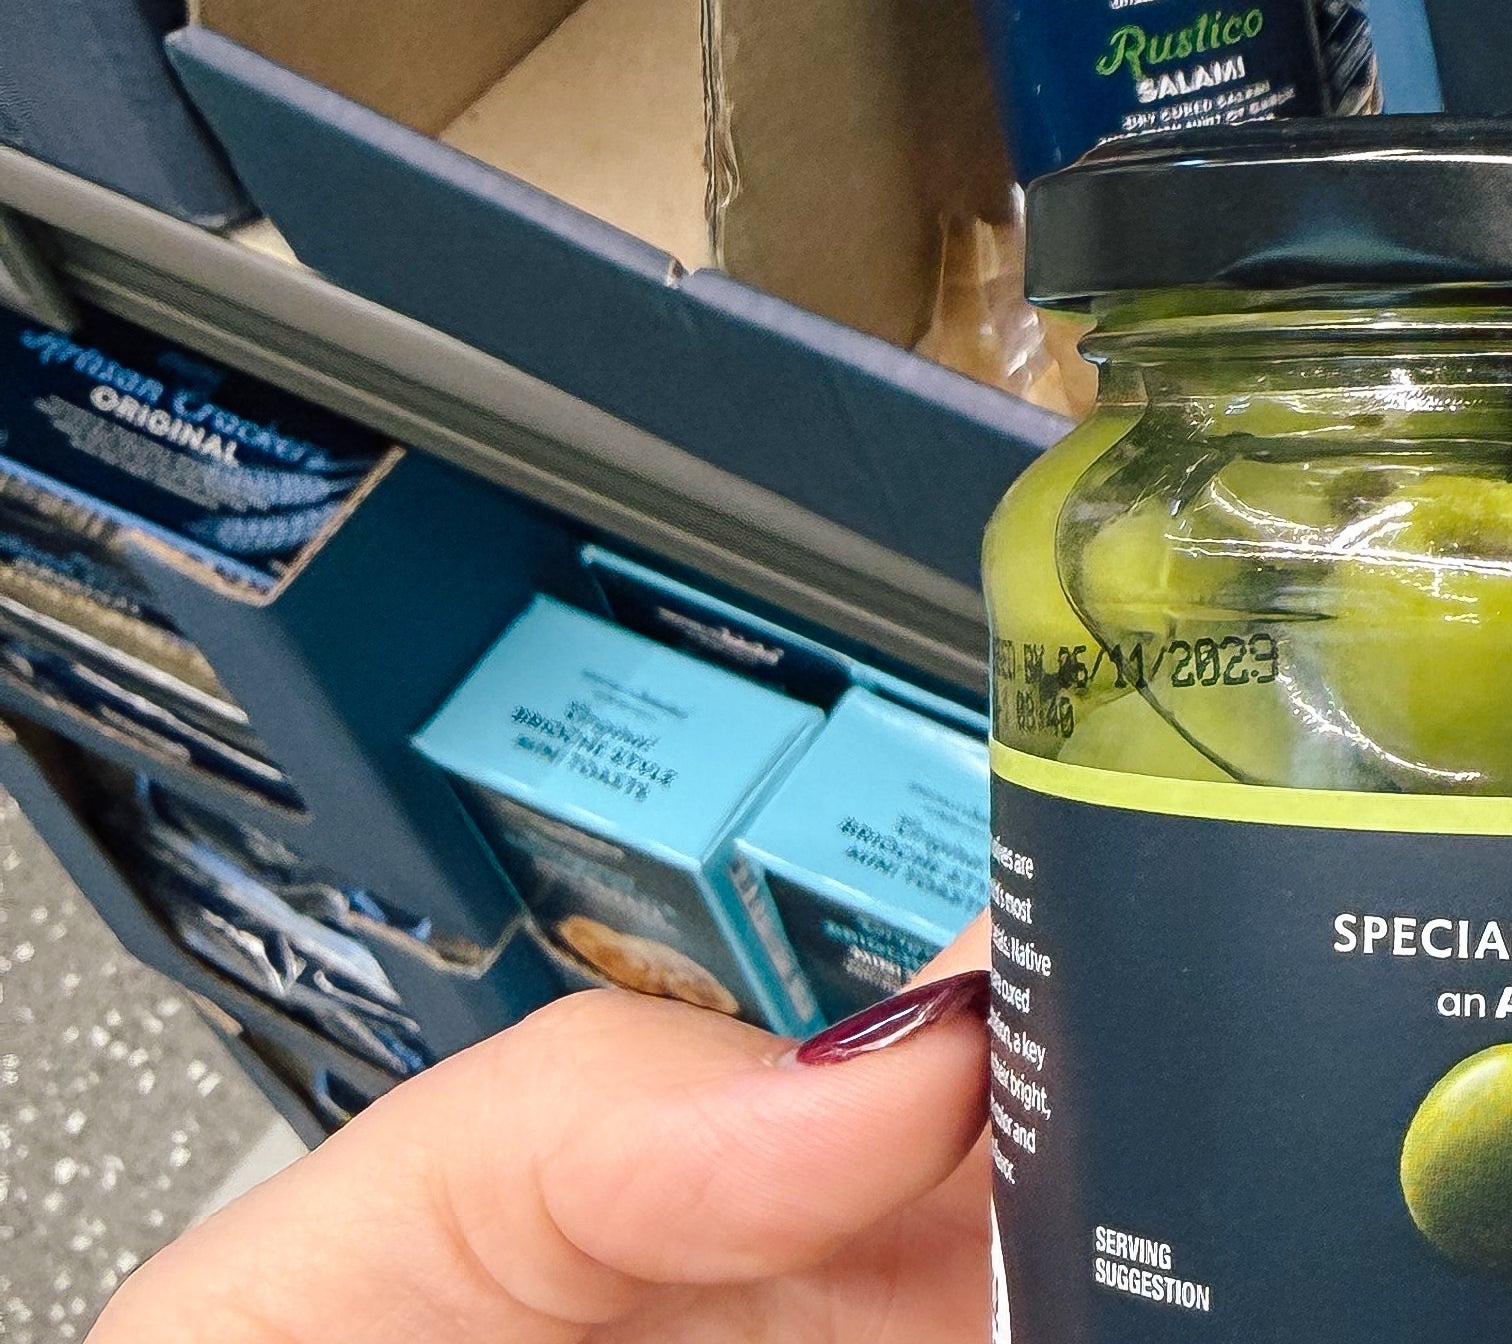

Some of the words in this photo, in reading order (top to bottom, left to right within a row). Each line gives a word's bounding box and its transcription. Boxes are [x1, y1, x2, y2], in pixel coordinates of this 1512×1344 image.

[1095, 8, 1264, 78] Rustico
[1136, 55, 1247, 104] SALAMI
[89, 385, 239, 466] ORIGINAL
[1010, 935, 1052, 977] Native
[1436, 988, 1487, 1020] an
[1021, 1030, 1047, 1071] key
[1010, 1067, 1052, 1121] bright,
[1013, 1121, 1036, 1155] and
[1094, 1224, 1173, 1271] SERVING
[1094, 1257, 1210, 1312] SUGGESTION
